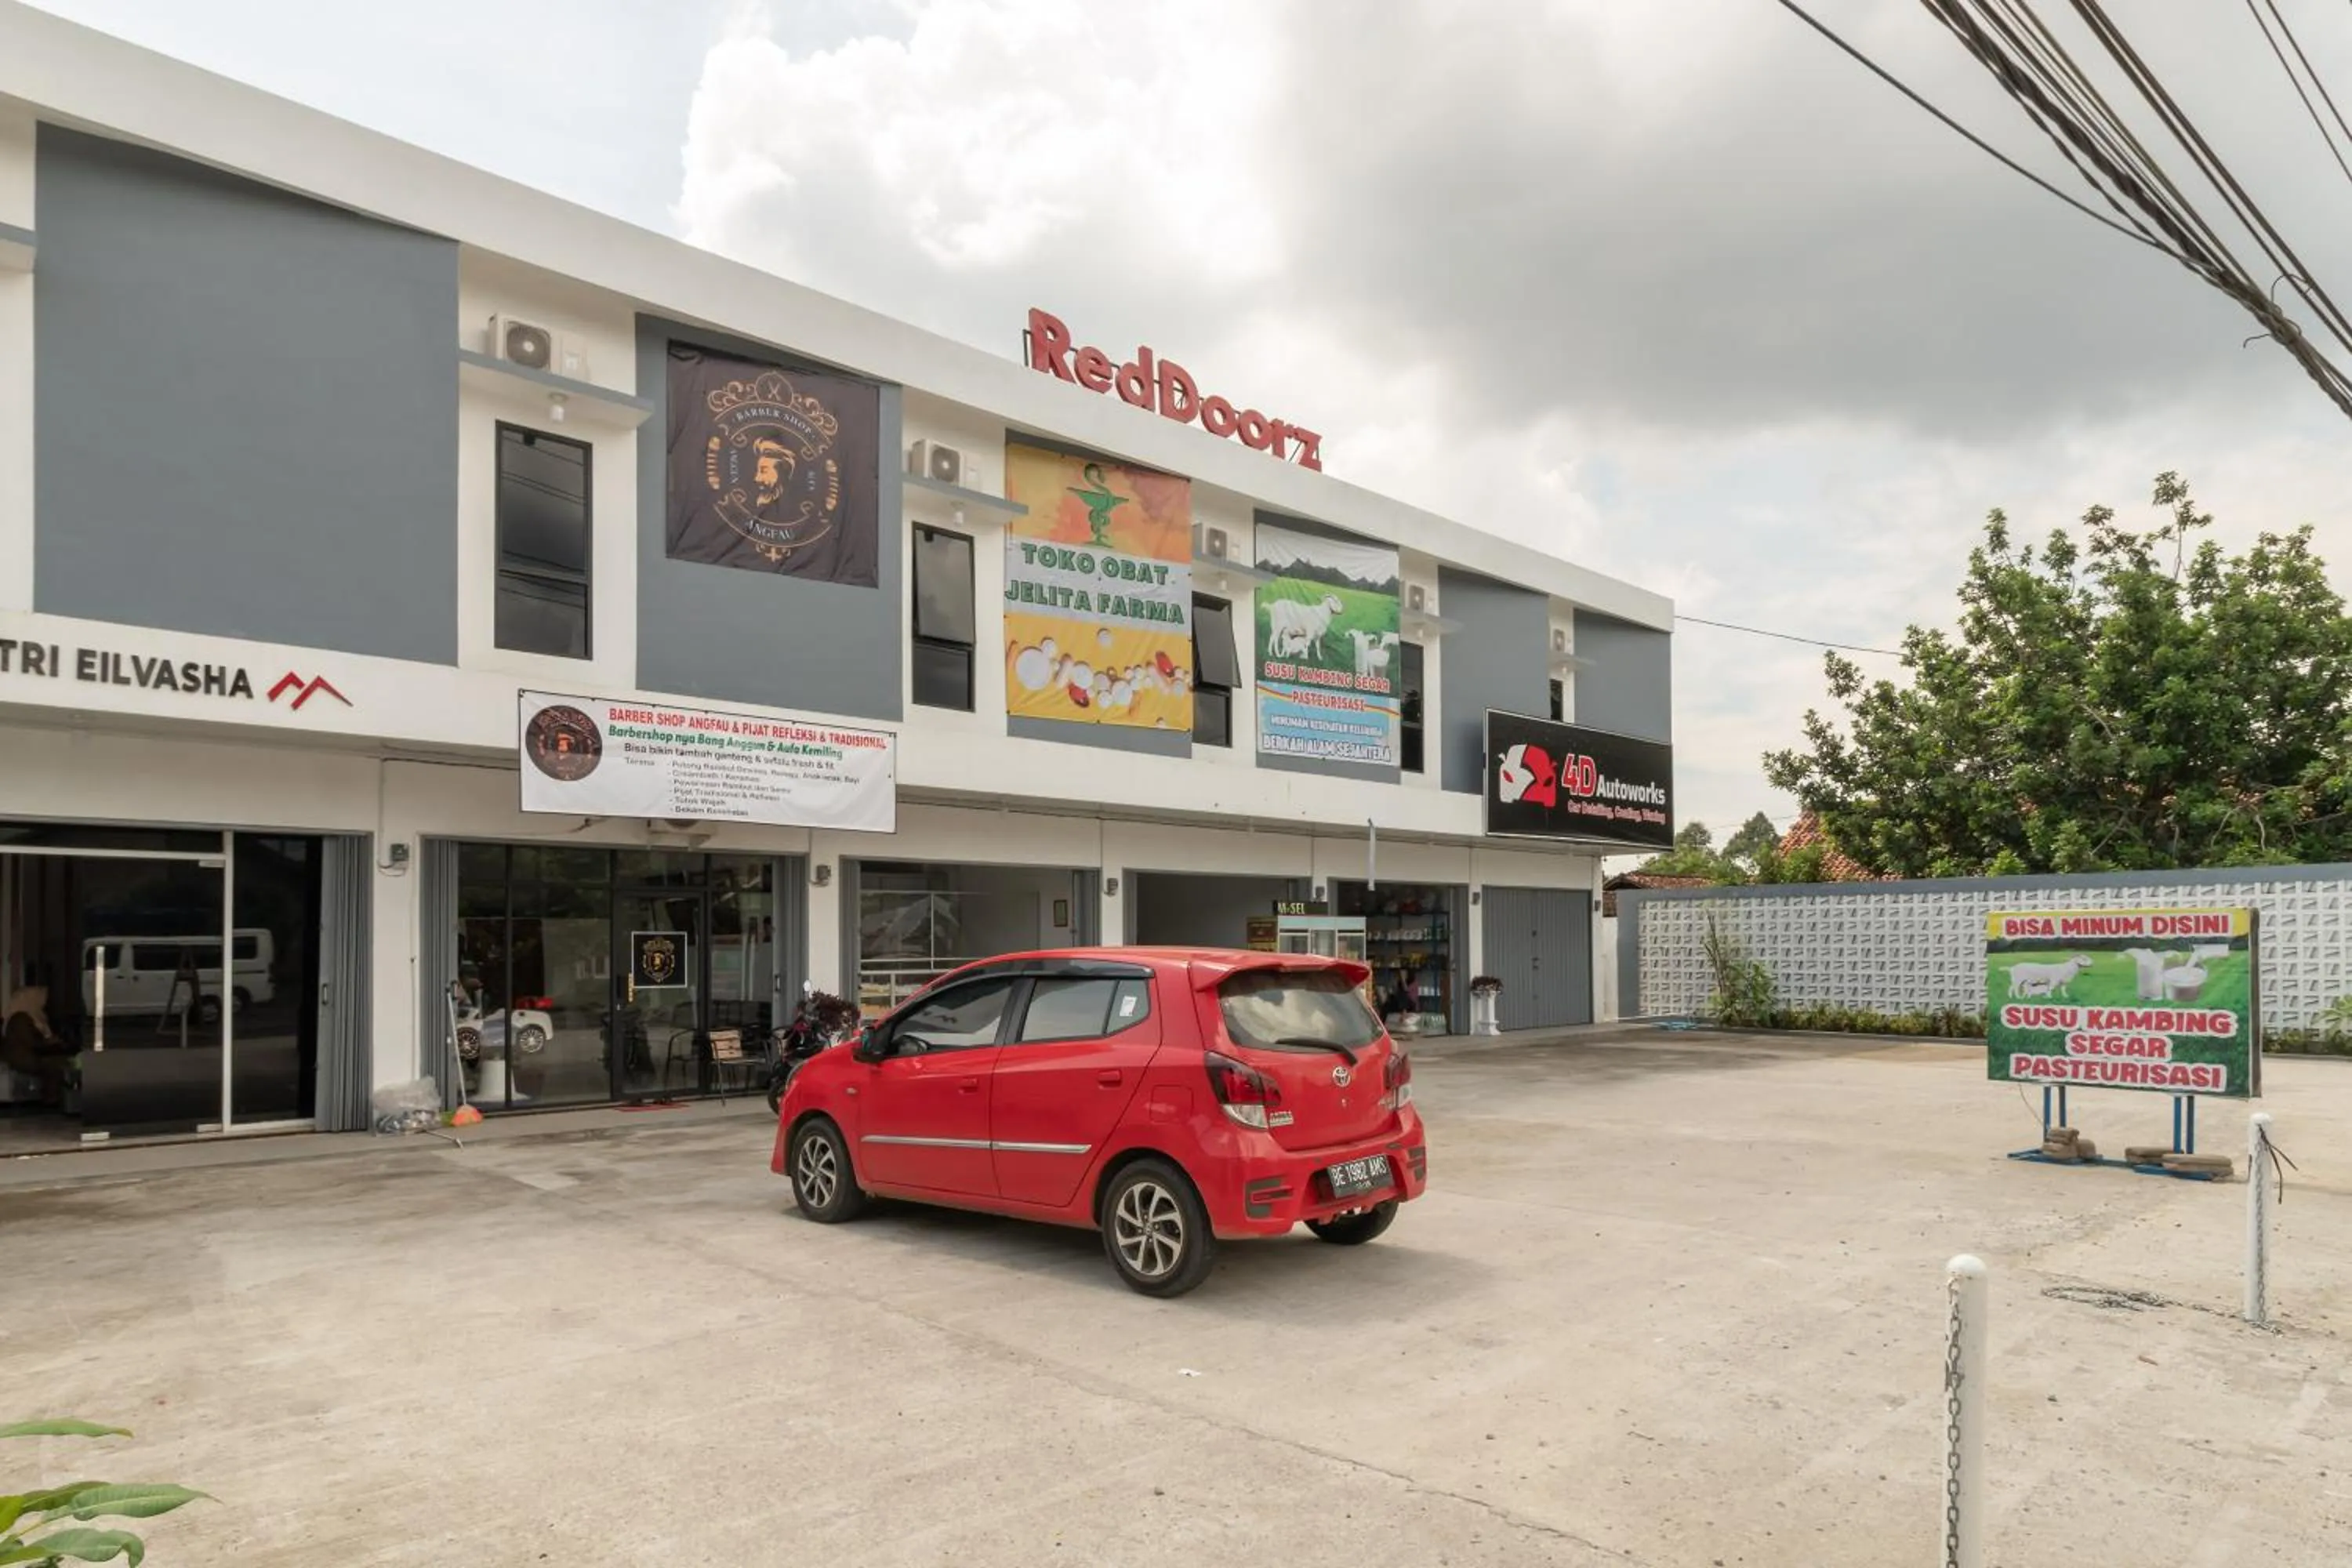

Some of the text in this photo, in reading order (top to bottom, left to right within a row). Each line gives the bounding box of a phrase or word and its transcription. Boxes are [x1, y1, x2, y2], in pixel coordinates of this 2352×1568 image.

[1029, 307, 1323, 472] RedDoorz
[735, 406, 813, 434] BARBER SHOP
[1020, 542, 1169, 586] TOKO OBAT
[1004, 579, 1185, 625] JELITA FARMA
[0, 639, 254, 699] TRI EILVASHA
[1265, 661, 1390, 693] SUSU KAMBING SEGAR
[1292, 690, 1365, 712] PASTEURISASI
[608, 724, 673, 742] Barbershop
[675, 734, 695, 746] nya
[697, 733, 724, 749] Bang
[767, 741, 775, 751] &
[609, 707, 654, 724] BARBER
[656, 712, 685, 727] SHOP
[732, 722, 739, 733] &
[742, 722, 769, 737] PIJAT
[772, 725, 815, 742] REFLEKSI
[820, 734, 826, 742] &
[829, 732, 887, 750] TRADISIONAL
[624, 742, 647, 754] Bisa
[1562, 753, 1666, 805] 4D Autoworks
[2005, 915, 2230, 935] BISA MINUM DISINI
[2005, 1006, 2232, 1034] SUSU KAMBING
[2069, 1035, 2168, 1058] SEGAR
[2013, 1056, 2222, 1088] PASTEURISASI
[1330, 1166, 1346, 1186] BE
